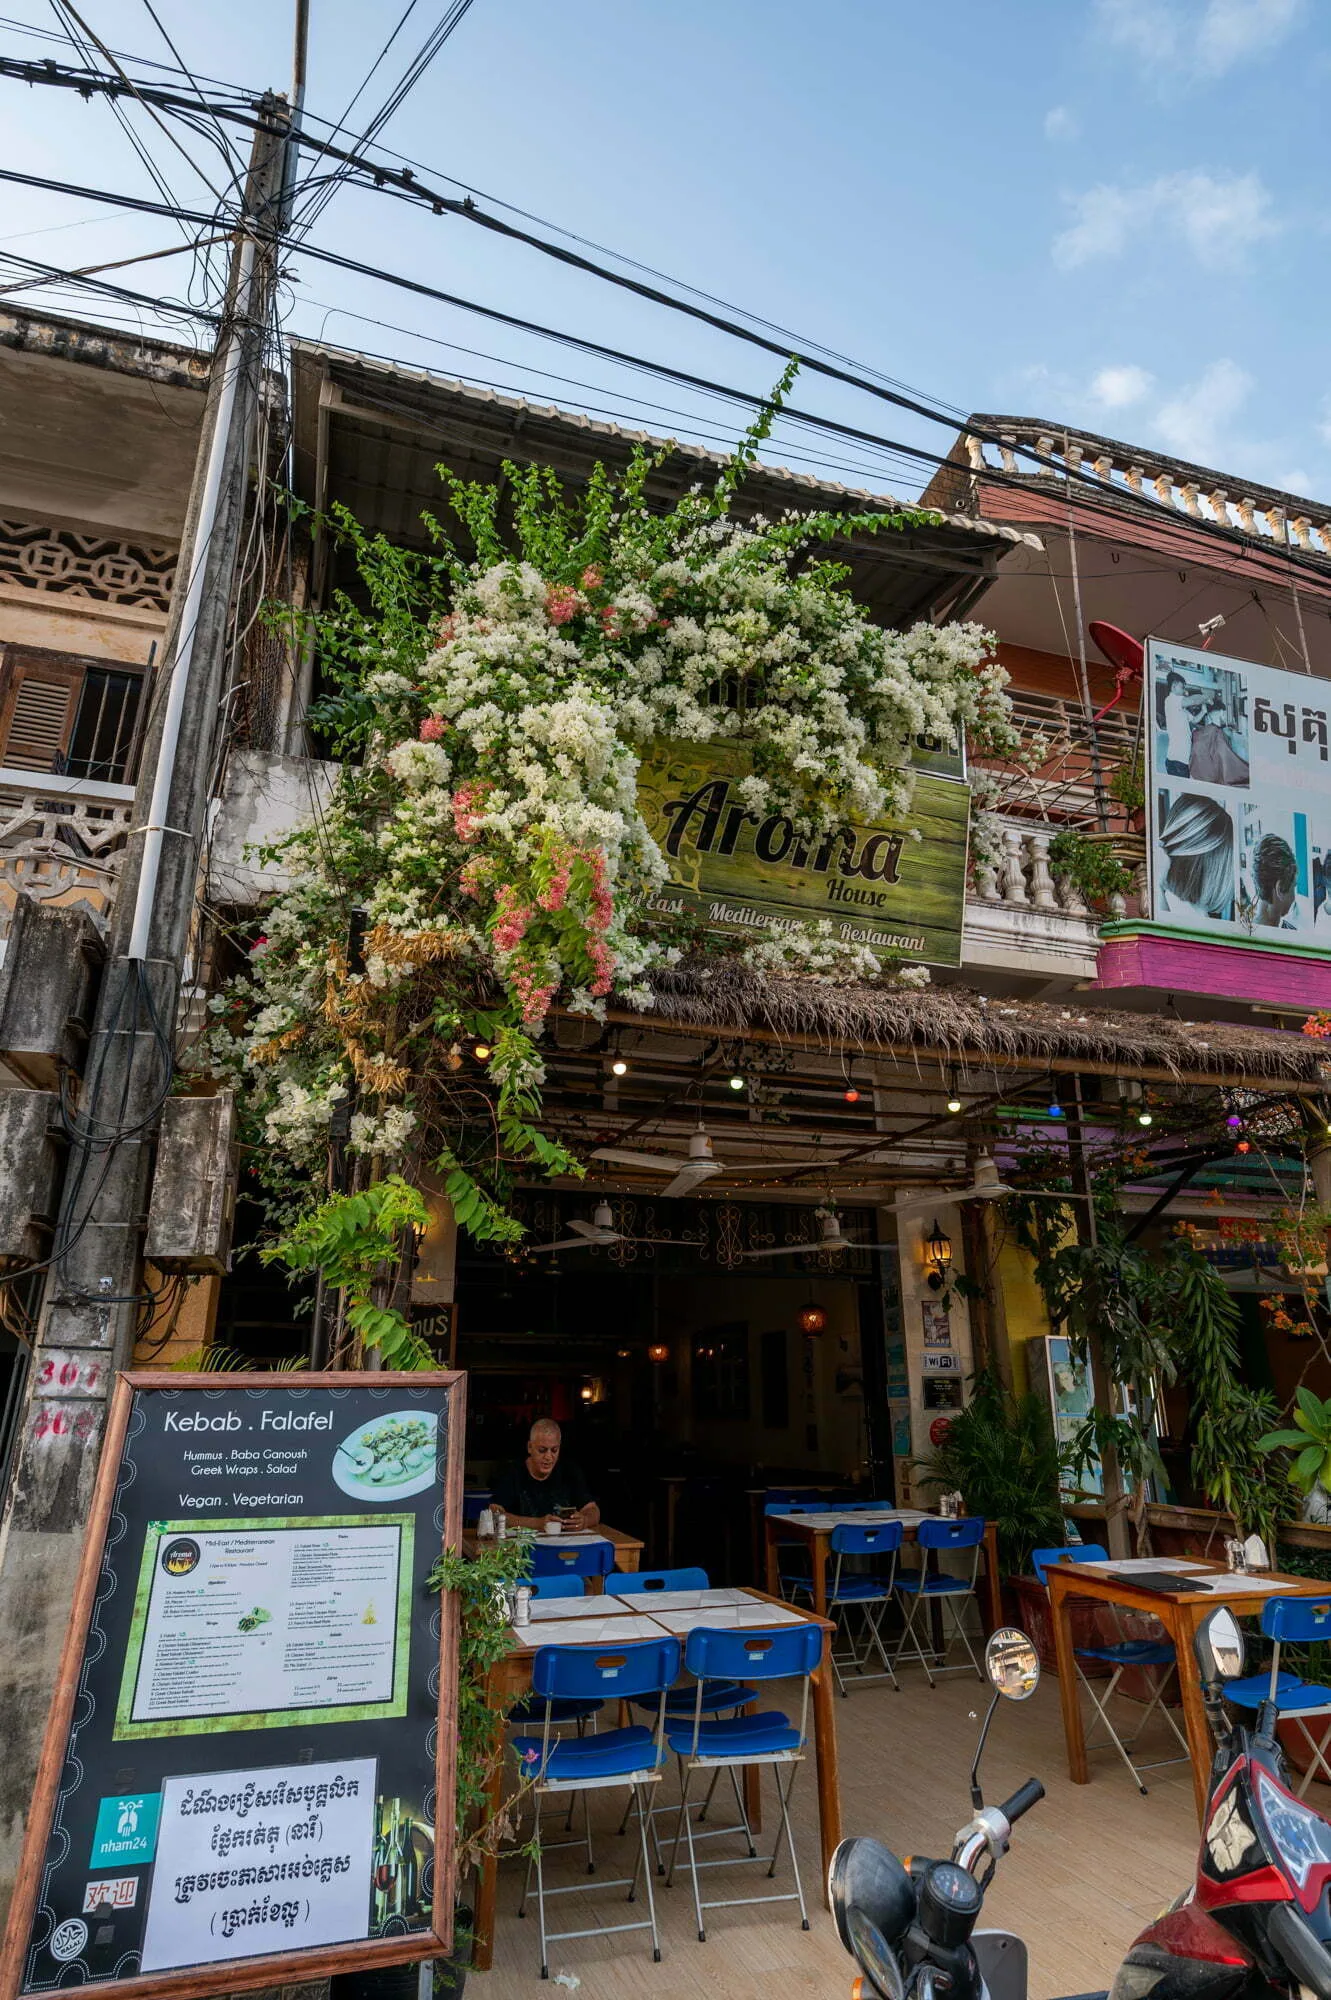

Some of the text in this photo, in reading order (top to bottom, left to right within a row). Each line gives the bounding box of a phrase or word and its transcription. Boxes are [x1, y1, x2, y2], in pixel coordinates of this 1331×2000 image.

[662, 779, 905, 886] Aroma
[826, 878, 888, 908] House
[646, 892, 684, 915] East
[839, 922, 926, 951] Restaurant
[164, 1411, 242, 1432] Kebab
[260, 1410, 334, 1431] Falafel
[184, 1450, 223, 1461] Hummus
[231, 1449, 260, 1461] Baba
[262, 1449, 308, 1460] Ganoush
[191, 1465, 223, 1476] Greek
[225, 1464, 258, 1477] Wraps
[266, 1463, 298, 1474] Salad
[178, 1494, 222, 1509] Vegan
[232, 1492, 304, 1508] Vegetarian
[101, 1836, 148, 1854] nham24
[86, 1880, 135, 1908] 欢迎
